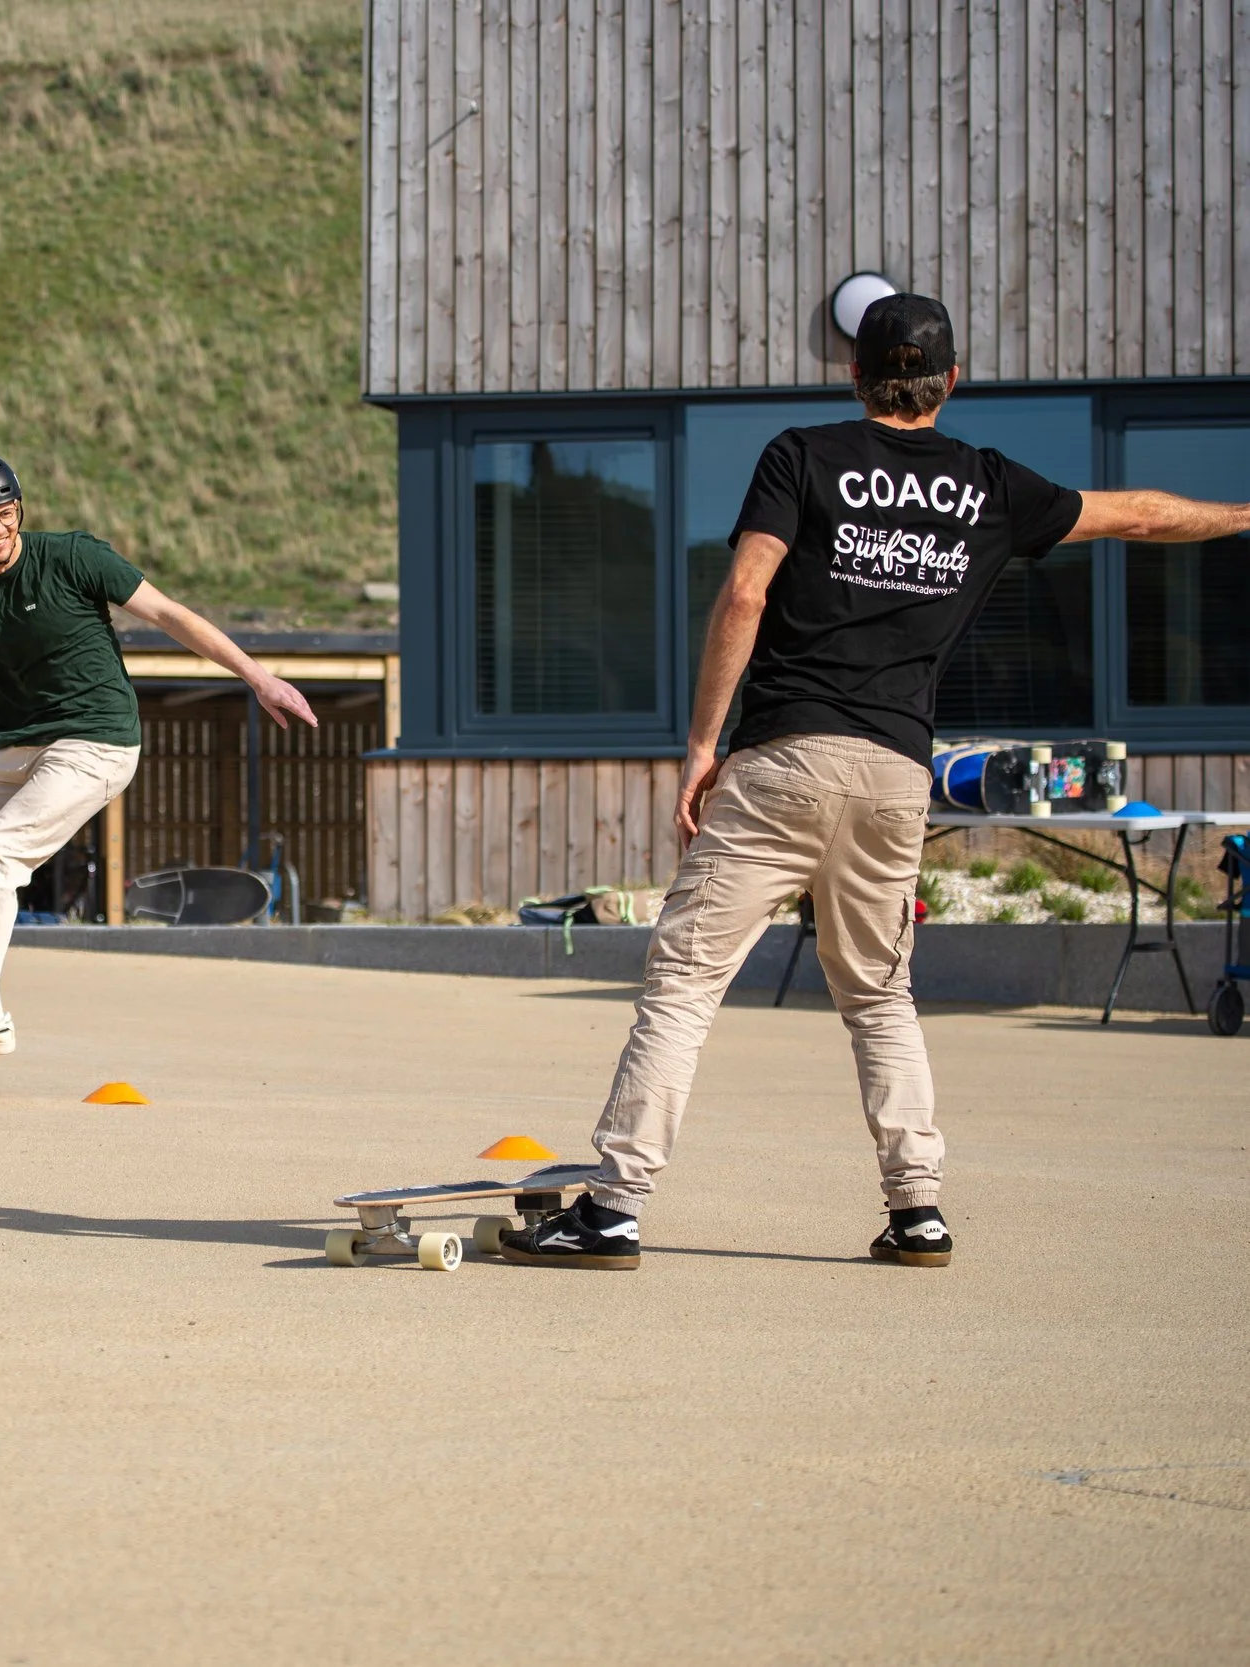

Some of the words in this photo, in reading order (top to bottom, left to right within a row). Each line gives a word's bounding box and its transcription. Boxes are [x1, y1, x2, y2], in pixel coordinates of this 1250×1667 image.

[838, 468, 986, 526] COACH
[834, 523, 970, 573] SurfSkate
[859, 526, 888, 543] THE
[832, 553, 964, 584] ACADEMY
